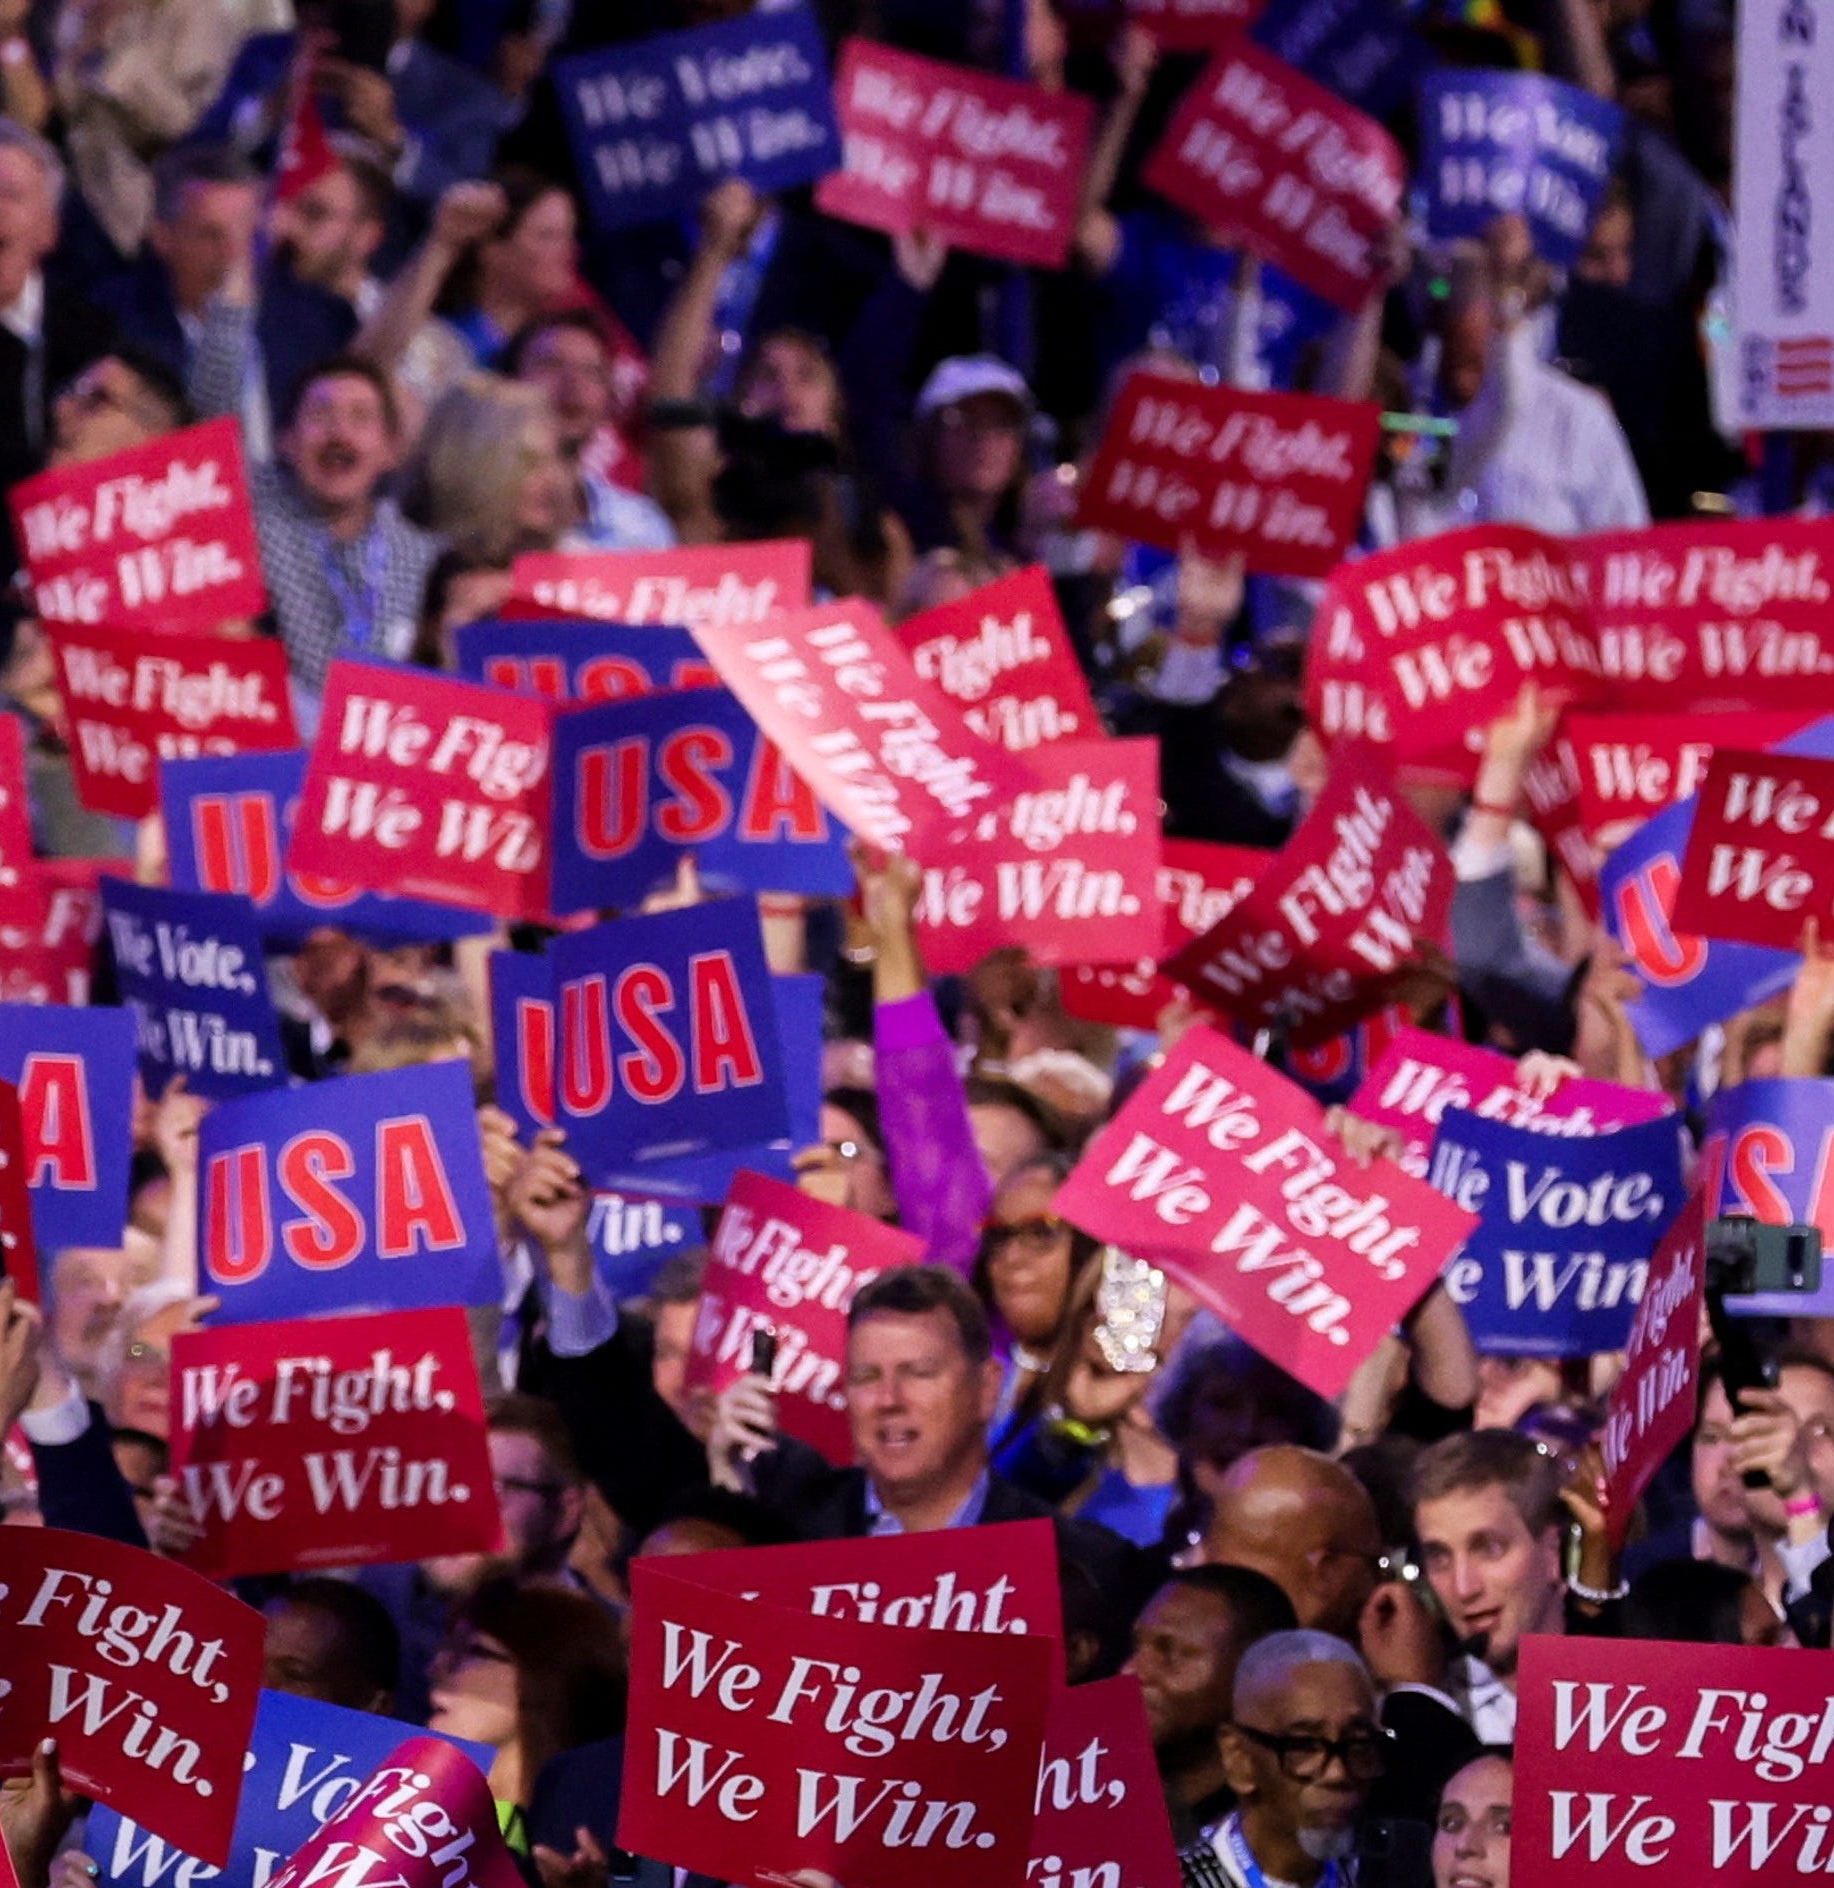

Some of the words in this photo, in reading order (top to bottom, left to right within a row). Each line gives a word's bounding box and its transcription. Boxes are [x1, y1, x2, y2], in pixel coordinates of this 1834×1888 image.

[1725, 775, 1818, 832] We
[1709, 845, 1812, 909] We
[559, 950, 763, 1117] USA
[207, 1115, 466, 1285] USA
[1163, 1063, 1257, 1151] We
[1242, 1128, 1410, 1281] Fight,
[1507, 1161, 1662, 1227] Vote,
[1106, 1133, 1210, 1224] We
[1211, 1203, 1351, 1345] Win.
[183, 1363, 257, 1429] We
[272, 1348, 455, 1433] Fight,
[186, 1459, 285, 1522] We
[305, 1448, 469, 1513] Win.
[18, 1569, 228, 1718] Fight,
[663, 1621, 760, 1711] We
[767, 1657, 1007, 1756] Fight,
[39, 1665, 212, 1796] Win.
[1553, 1681, 1666, 1755] We
[656, 1728, 764, 1821] We
[797, 1769, 995, 1848] Win.
[1549, 1791, 1675, 1865] We
